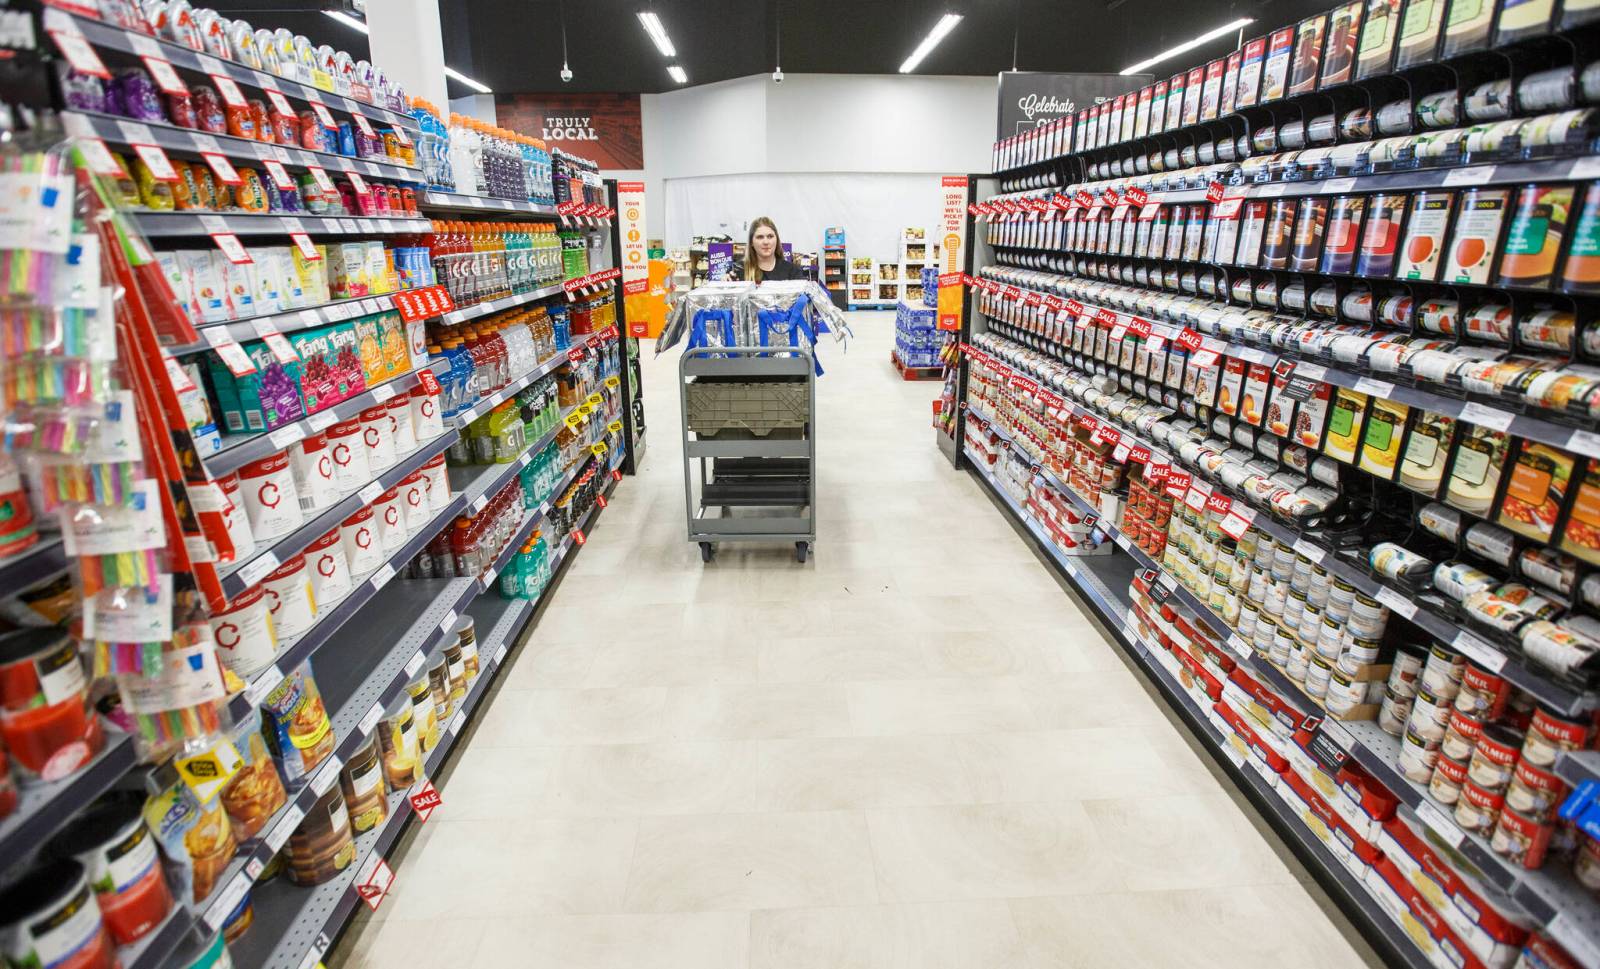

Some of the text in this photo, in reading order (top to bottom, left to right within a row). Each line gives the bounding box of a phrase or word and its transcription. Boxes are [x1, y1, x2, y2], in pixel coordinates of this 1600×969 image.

[1018, 93, 1075, 120] Celebrate
[546, 117, 590, 127] TRULY
[542, 128, 599, 140] LOCAL
[1128, 189, 1146, 204] SALE
[1208, 185, 1223, 200] SALE
[1054, 196, 1069, 207] SALE
[1077, 193, 1092, 207] SALE
[1105, 191, 1118, 206] SALE
[559, 203, 574, 214] SALE
[574, 205, 587, 214] SALE
[1020, 199, 1032, 210] SALE
[1033, 200, 1047, 210] SALE
[566, 280, 580, 289] SALE
[964, 276, 974, 284] SALE
[975, 278, 985, 287] SALE
[1007, 287, 1019, 297] SALE
[1028, 295, 1040, 303] SALE
[1047, 297, 1061, 307] SALE
[1067, 301, 1082, 314] SALE
[1099, 311, 1115, 323] SALE
[356, 320, 377, 338] Tang
[1131, 320, 1150, 334] SALE
[328, 329, 355, 351] Tang
[600, 331, 612, 339] SALE
[1180, 331, 1200, 348] SALE
[296, 336, 328, 359] Tang
[251, 348, 275, 370] Ta
[569, 350, 583, 360] SALE
[988, 360, 999, 369] SALE
[1000, 367, 1011, 375] SALE
[1013, 376, 1025, 385] SALE
[1024, 381, 1036, 391] SALE
[1049, 397, 1062, 407] SALE
[1081, 417, 1096, 429] SALE
[1101, 428, 1119, 442] SALE
[1131, 449, 1149, 460] SALE
[1151, 466, 1170, 477] SALE
[1167, 475, 1190, 488] SALE
[1207, 496, 1229, 510] SALE
[414, 792, 438, 807] SALE
